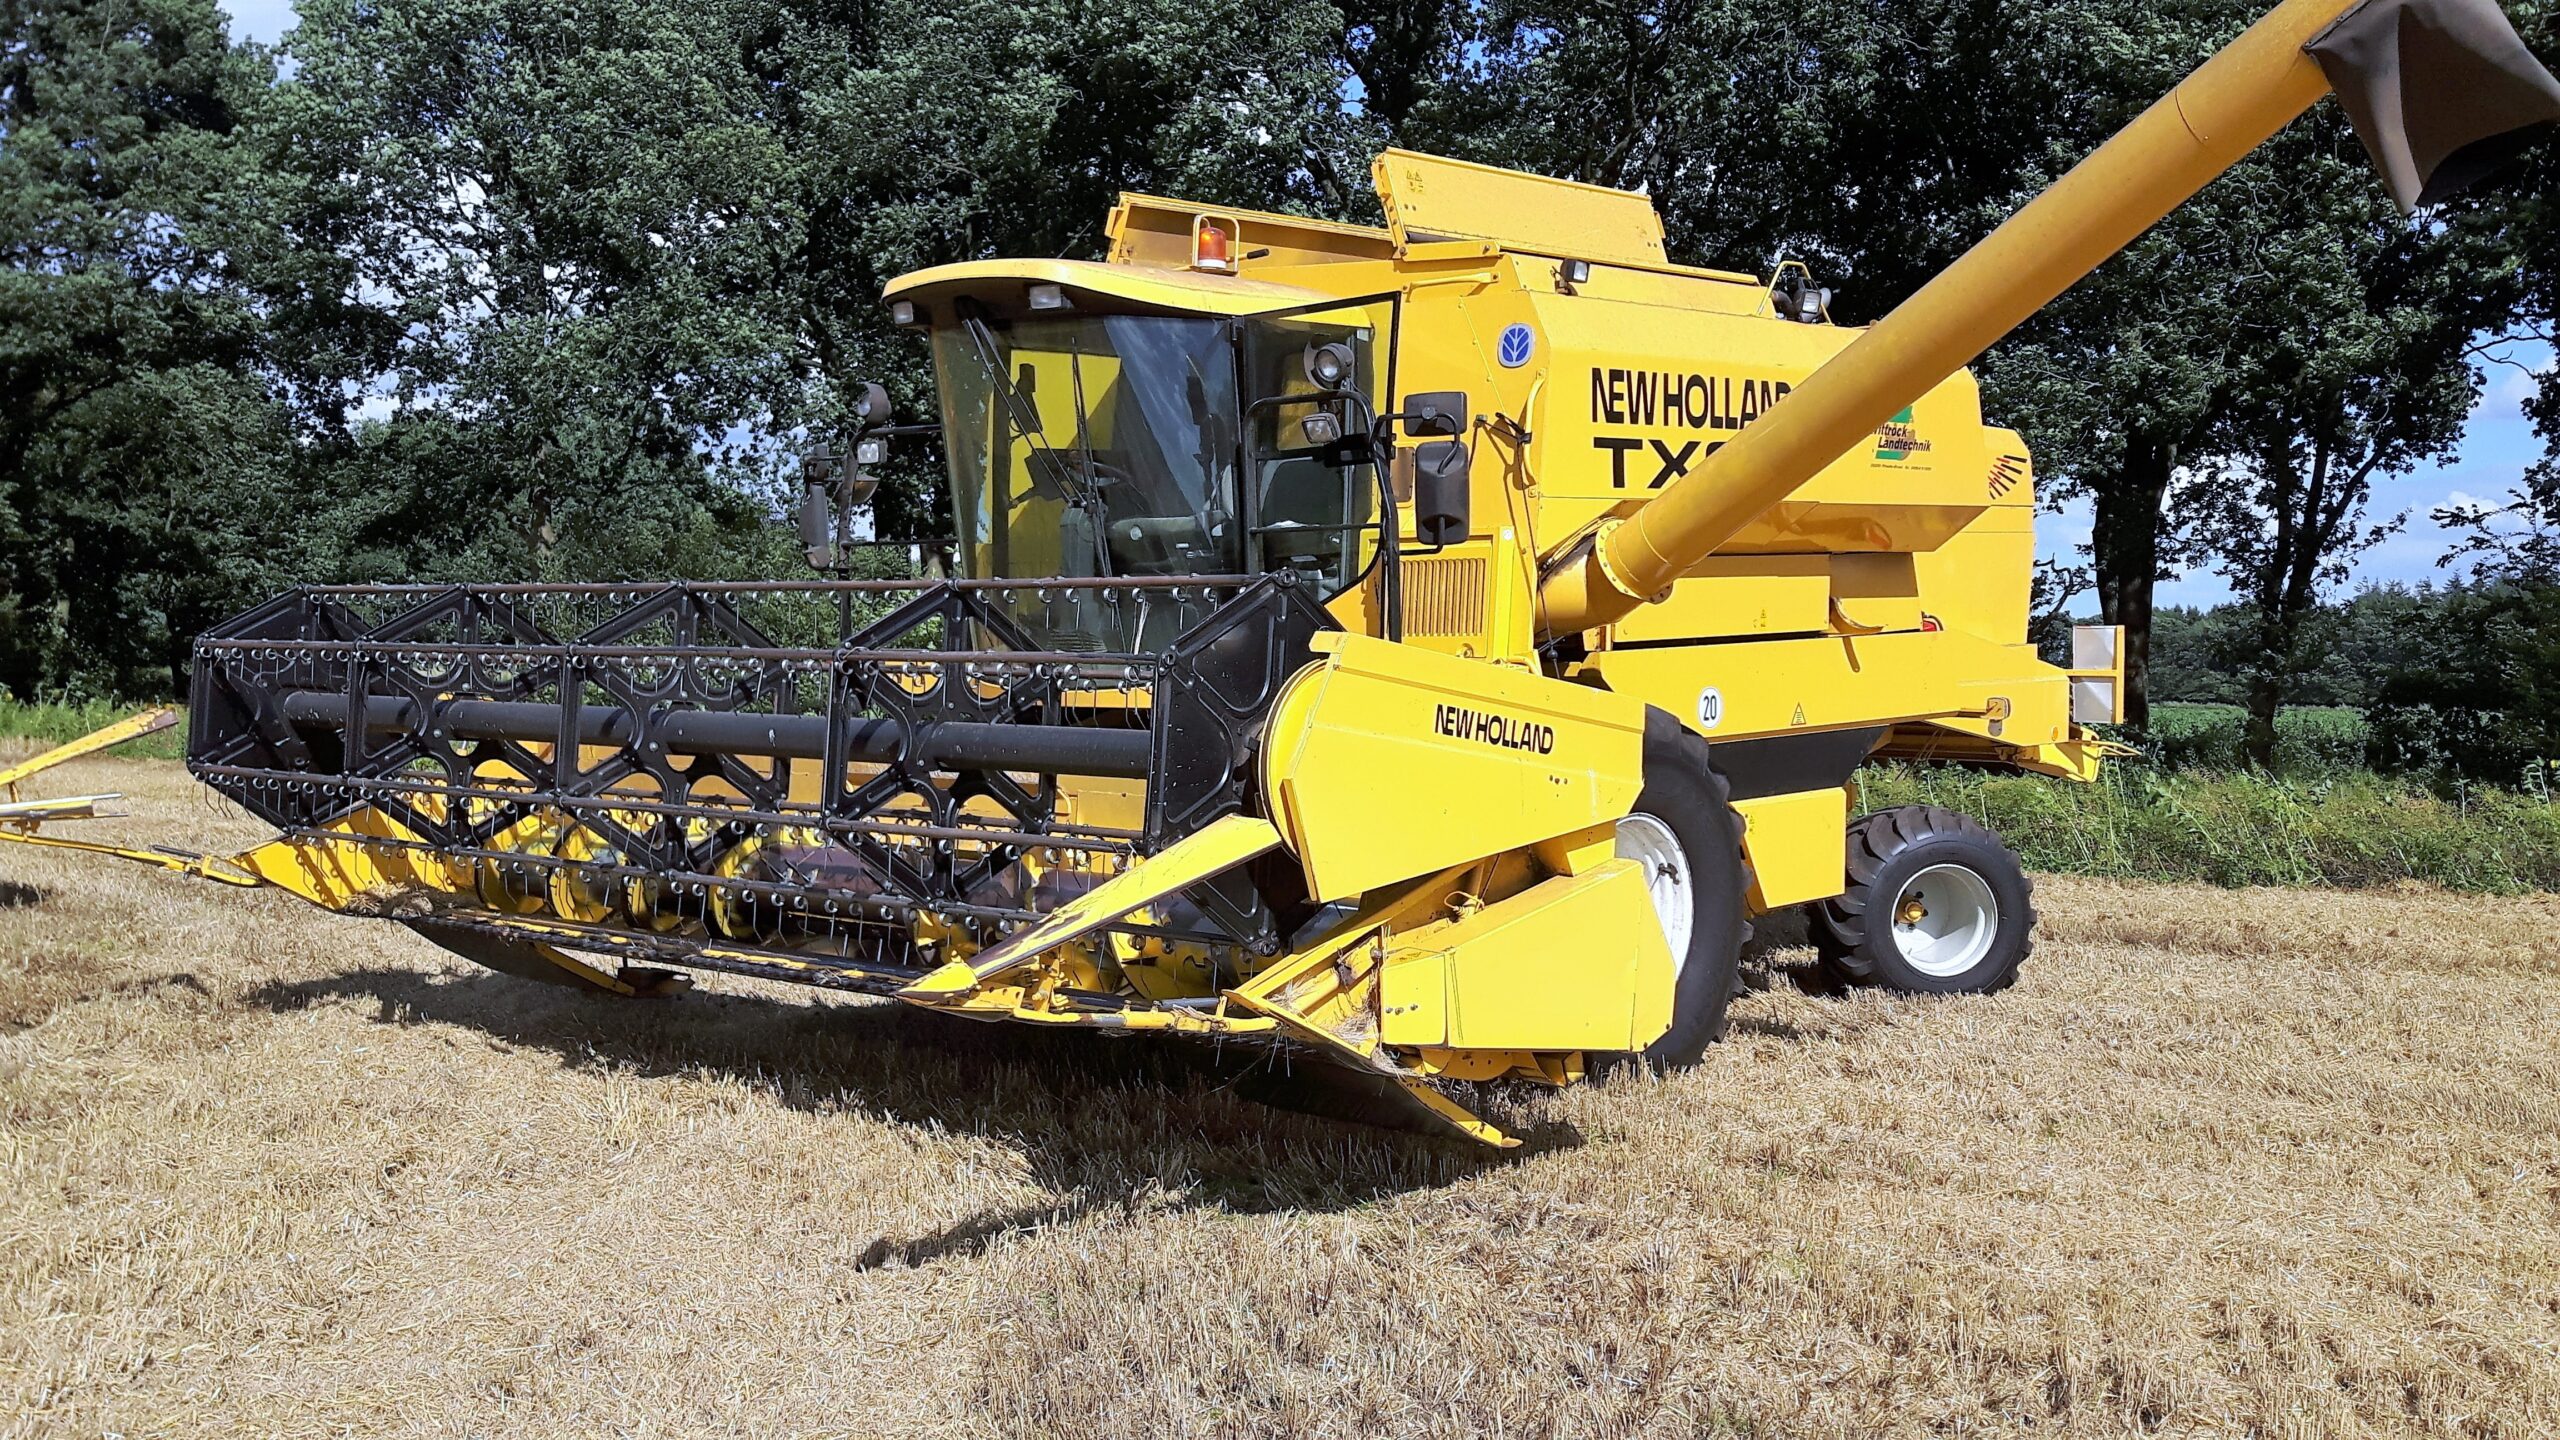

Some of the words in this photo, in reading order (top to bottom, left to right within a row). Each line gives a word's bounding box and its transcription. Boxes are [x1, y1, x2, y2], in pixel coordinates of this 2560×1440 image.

[1592, 367, 1657, 425] NEW
[1874, 423, 1908, 437] ittrock
[1878, 436, 1932, 452] Landtechnik
[1594, 437, 1729, 489] TX
[1703, 695, 1717, 721] 20
[1435, 704, 1475, 739] NEW
[1475, 712, 1554, 755] HOLLAND
